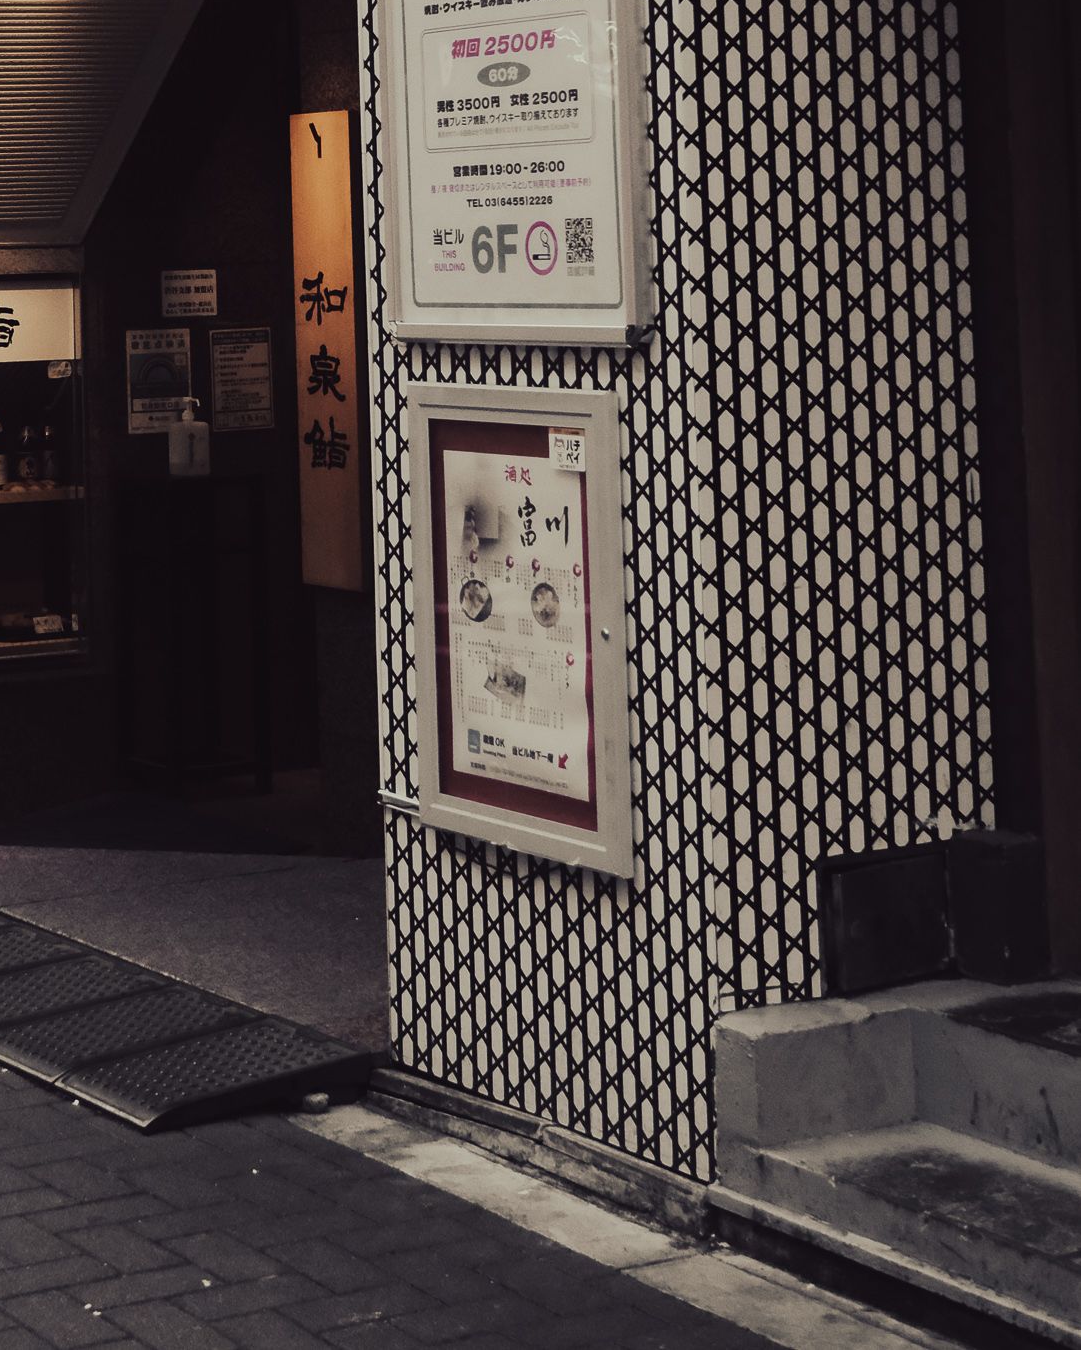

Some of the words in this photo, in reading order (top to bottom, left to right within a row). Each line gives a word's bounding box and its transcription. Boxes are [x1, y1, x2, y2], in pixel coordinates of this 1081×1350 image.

[451, 36, 481, 59] 初回
[484, 29, 556, 56] 2500円
[437, 99, 455, 113] 男性
[457, 95, 501, 112] 3500円
[510, 92, 530, 107] 女性
[532, 88, 579, 105] 2500円
[467, 198, 484, 208] TEL
[433, 228, 465, 246] 当ビル
[471, 223, 519, 274] 6F
[442, 250, 457, 259] THIS
[434, 263, 466, 272] BUILDING
[299, 271, 351, 471] 和泉鮨
[518, 495, 569, 548] 富川
